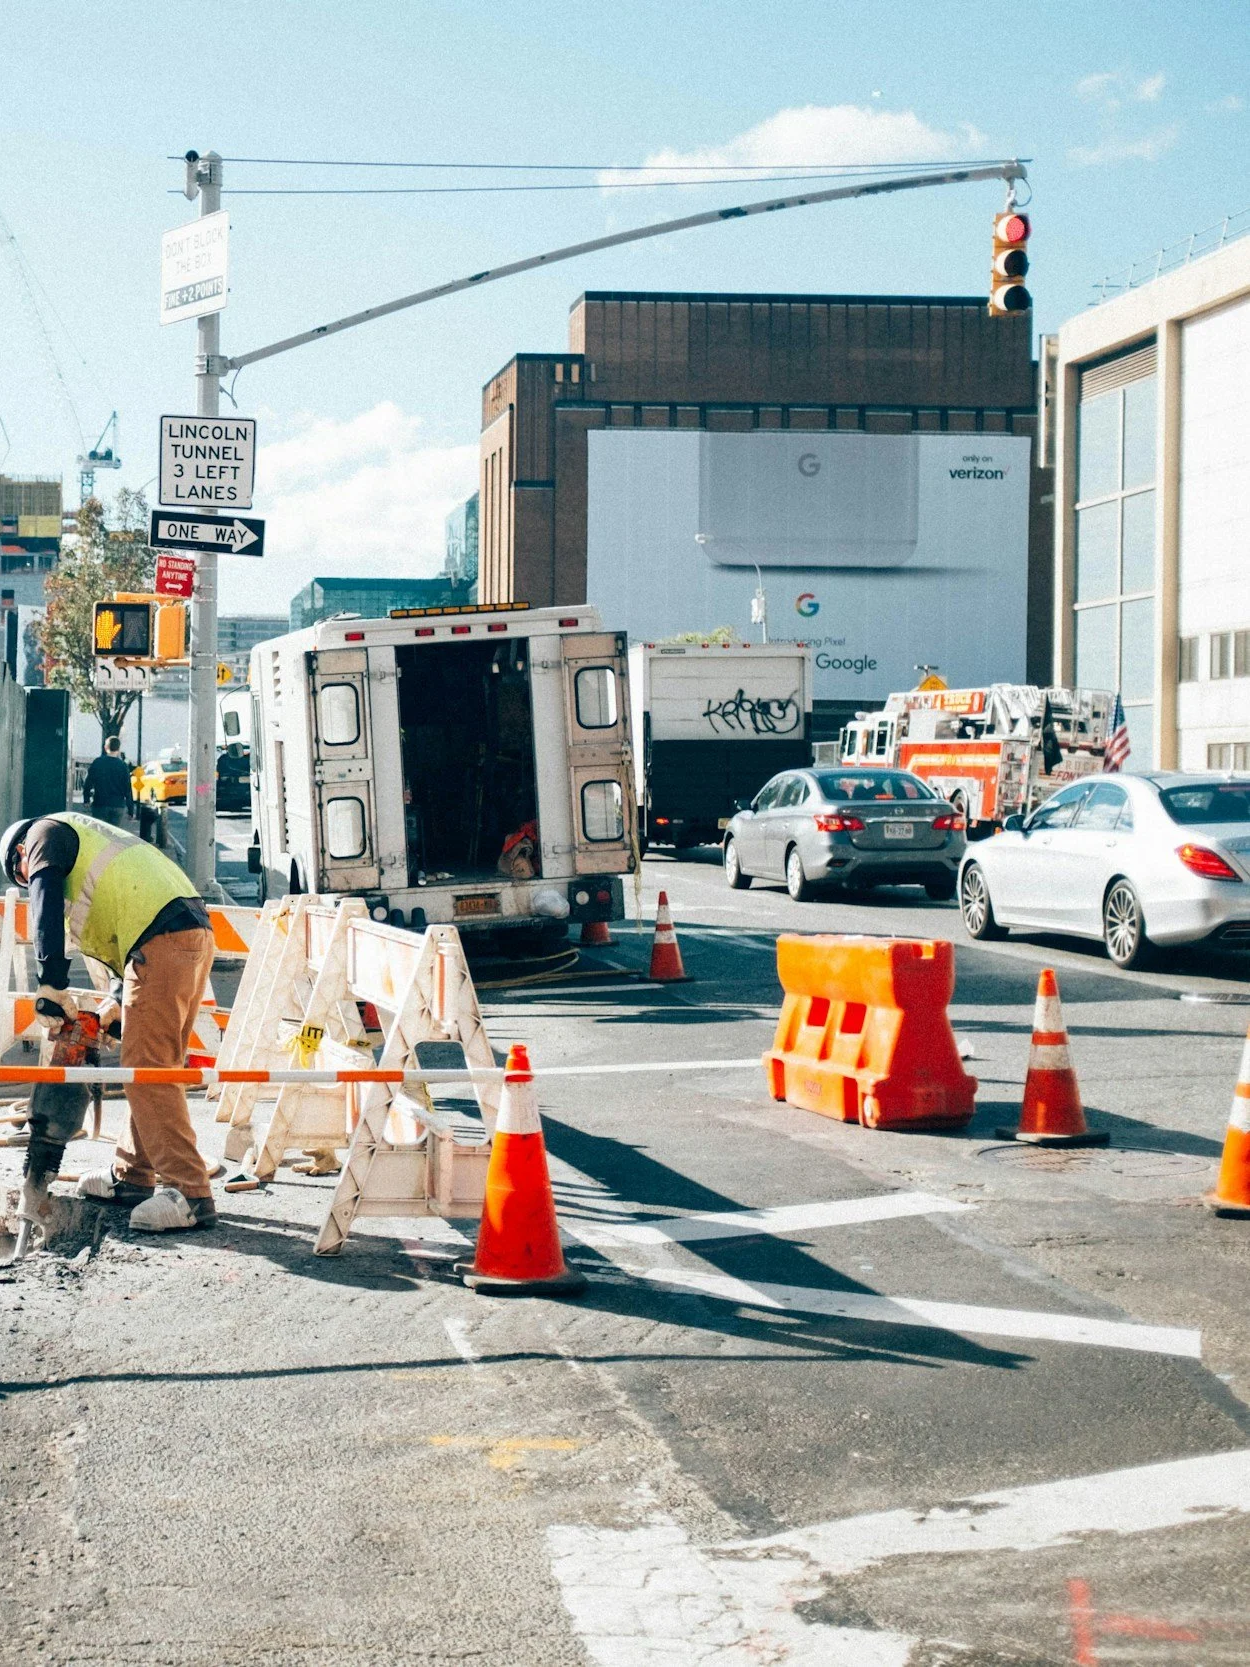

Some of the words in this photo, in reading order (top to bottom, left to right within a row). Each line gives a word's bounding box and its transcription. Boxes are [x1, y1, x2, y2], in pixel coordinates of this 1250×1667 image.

[193, 226, 224, 250] BLOCK
[176, 257, 191, 275] THE
[195, 250, 212, 270] BOX
[165, 290, 181, 309] FINE
[195, 277, 224, 301] POINTS
[169, 424, 247, 441] LINCOLN
[171, 444, 244, 461] TUNNEL
[962, 455, 980, 463] only
[173, 463, 184, 478] 3
[196, 465, 240, 480] LEFT
[949, 467, 1004, 480] verizon
[175, 484, 237, 501] LANES
[167, 523, 199, 540] ONE
[215, 527, 248, 544] WAY
[159, 559, 167, 568] NO
[168, 560, 193, 571] STANDING
[162, 570, 188, 581] ANYTIME
[824, 637, 846, 645] Pixel
[815, 653, 878, 674] Google
